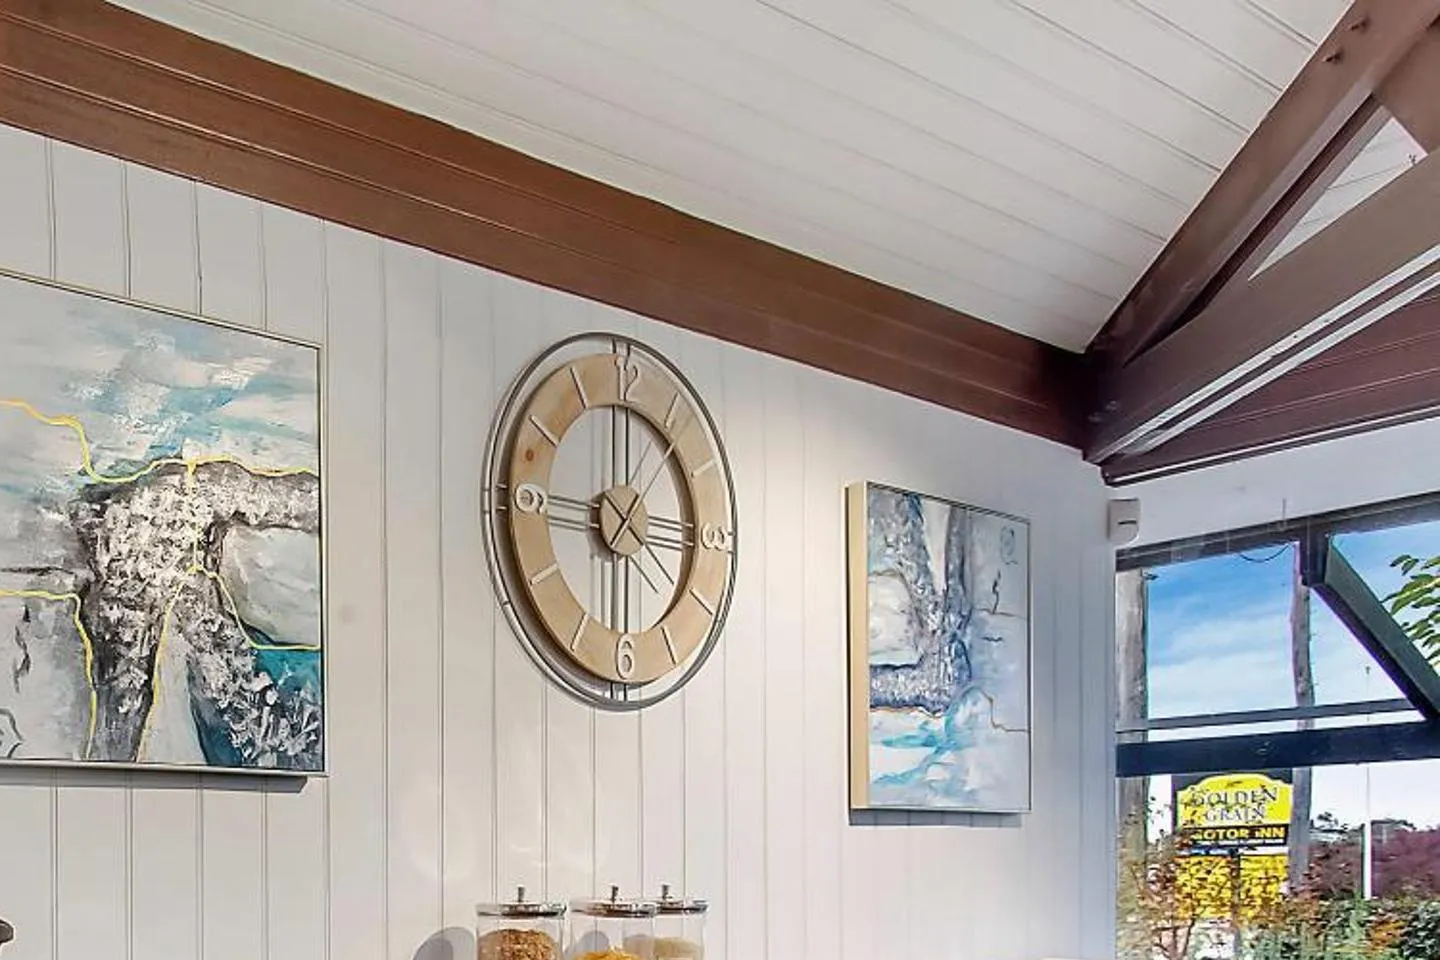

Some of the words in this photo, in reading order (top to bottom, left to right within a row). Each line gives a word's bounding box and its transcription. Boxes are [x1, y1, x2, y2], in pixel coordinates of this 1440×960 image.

[614, 355, 640, 401] 12
[514, 483, 548, 515] 9
[700, 523, 729, 551] 3
[616, 633, 635, 680] 6
[1204, 803, 1265, 821] GRAIN
